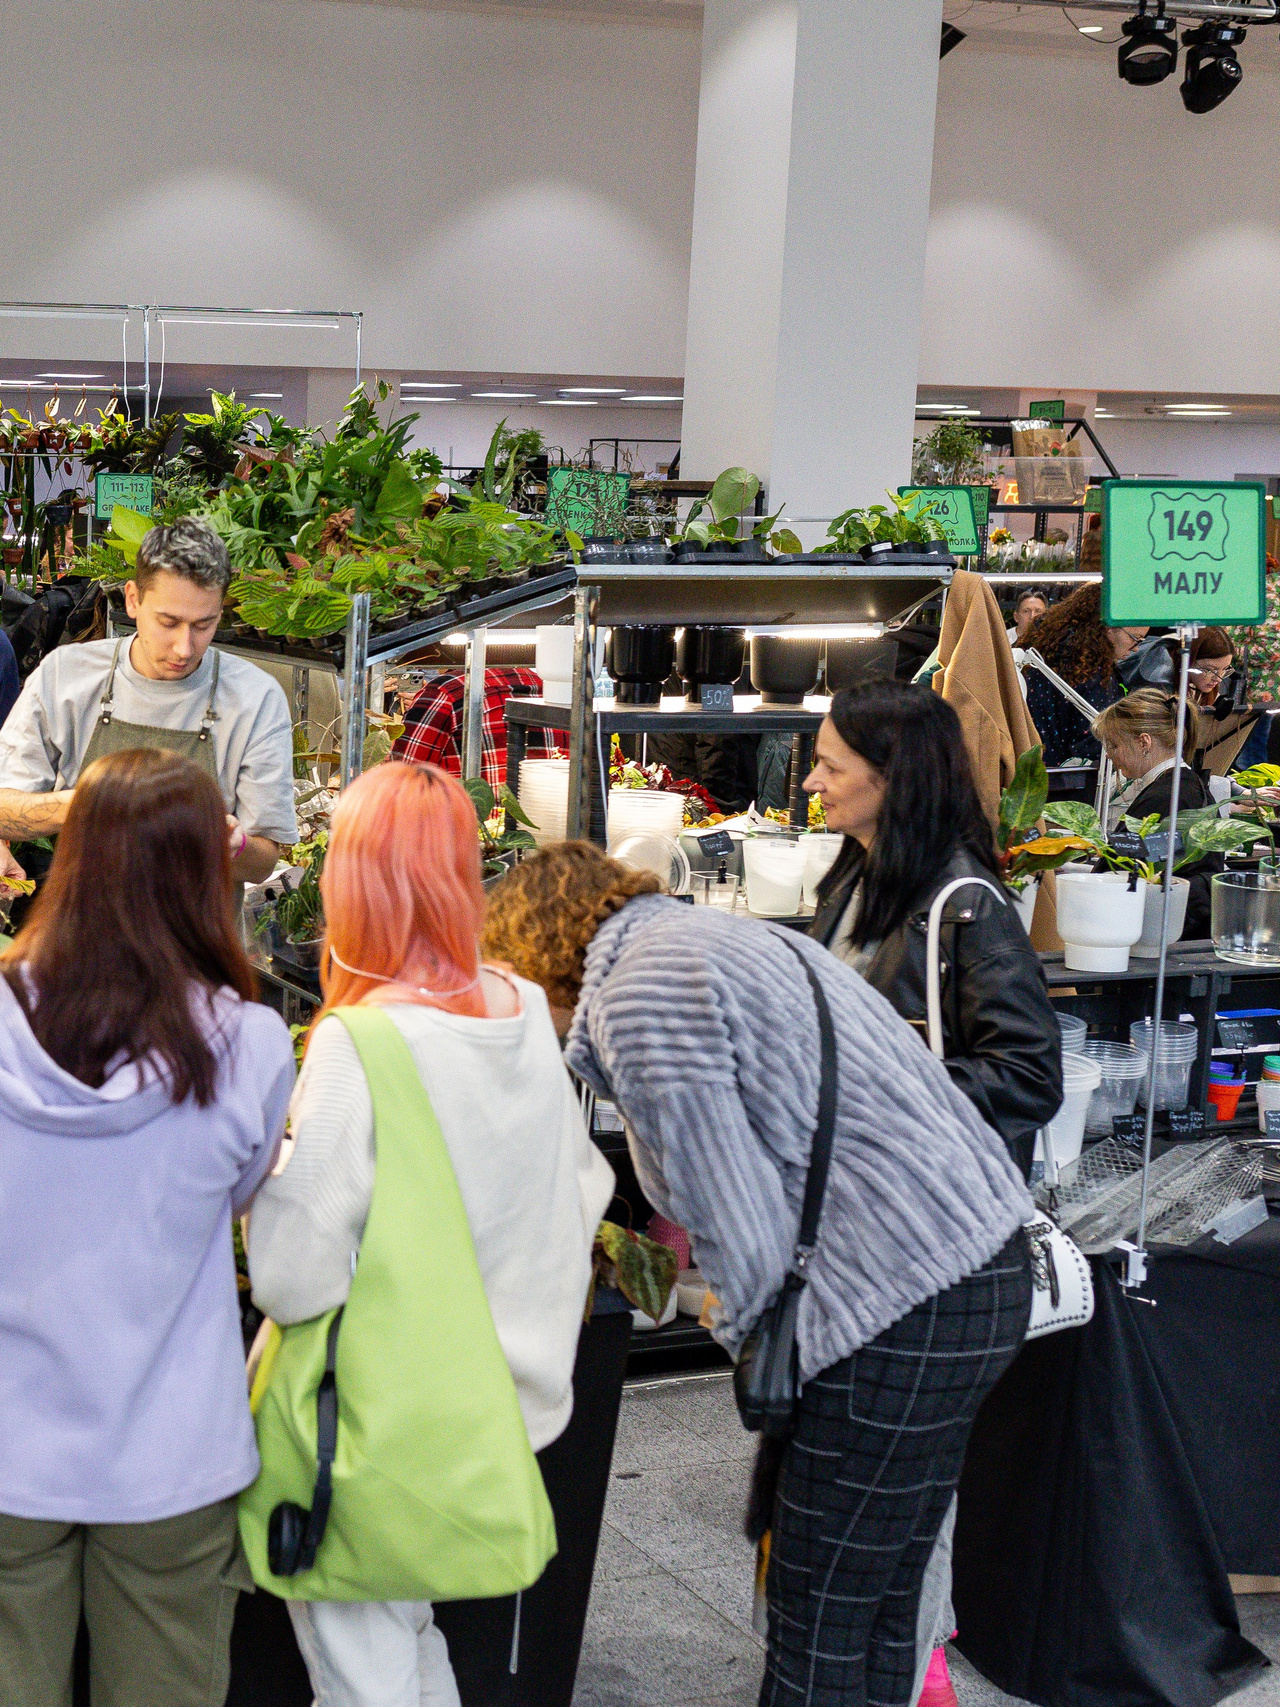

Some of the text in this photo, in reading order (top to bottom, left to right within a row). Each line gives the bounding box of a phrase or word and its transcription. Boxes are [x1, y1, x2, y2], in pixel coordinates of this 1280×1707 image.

[111, 482, 144, 492] 111-113
[1163, 510, 1213, 541] 149
[1154, 572, 1223, 594] МАЛУ
